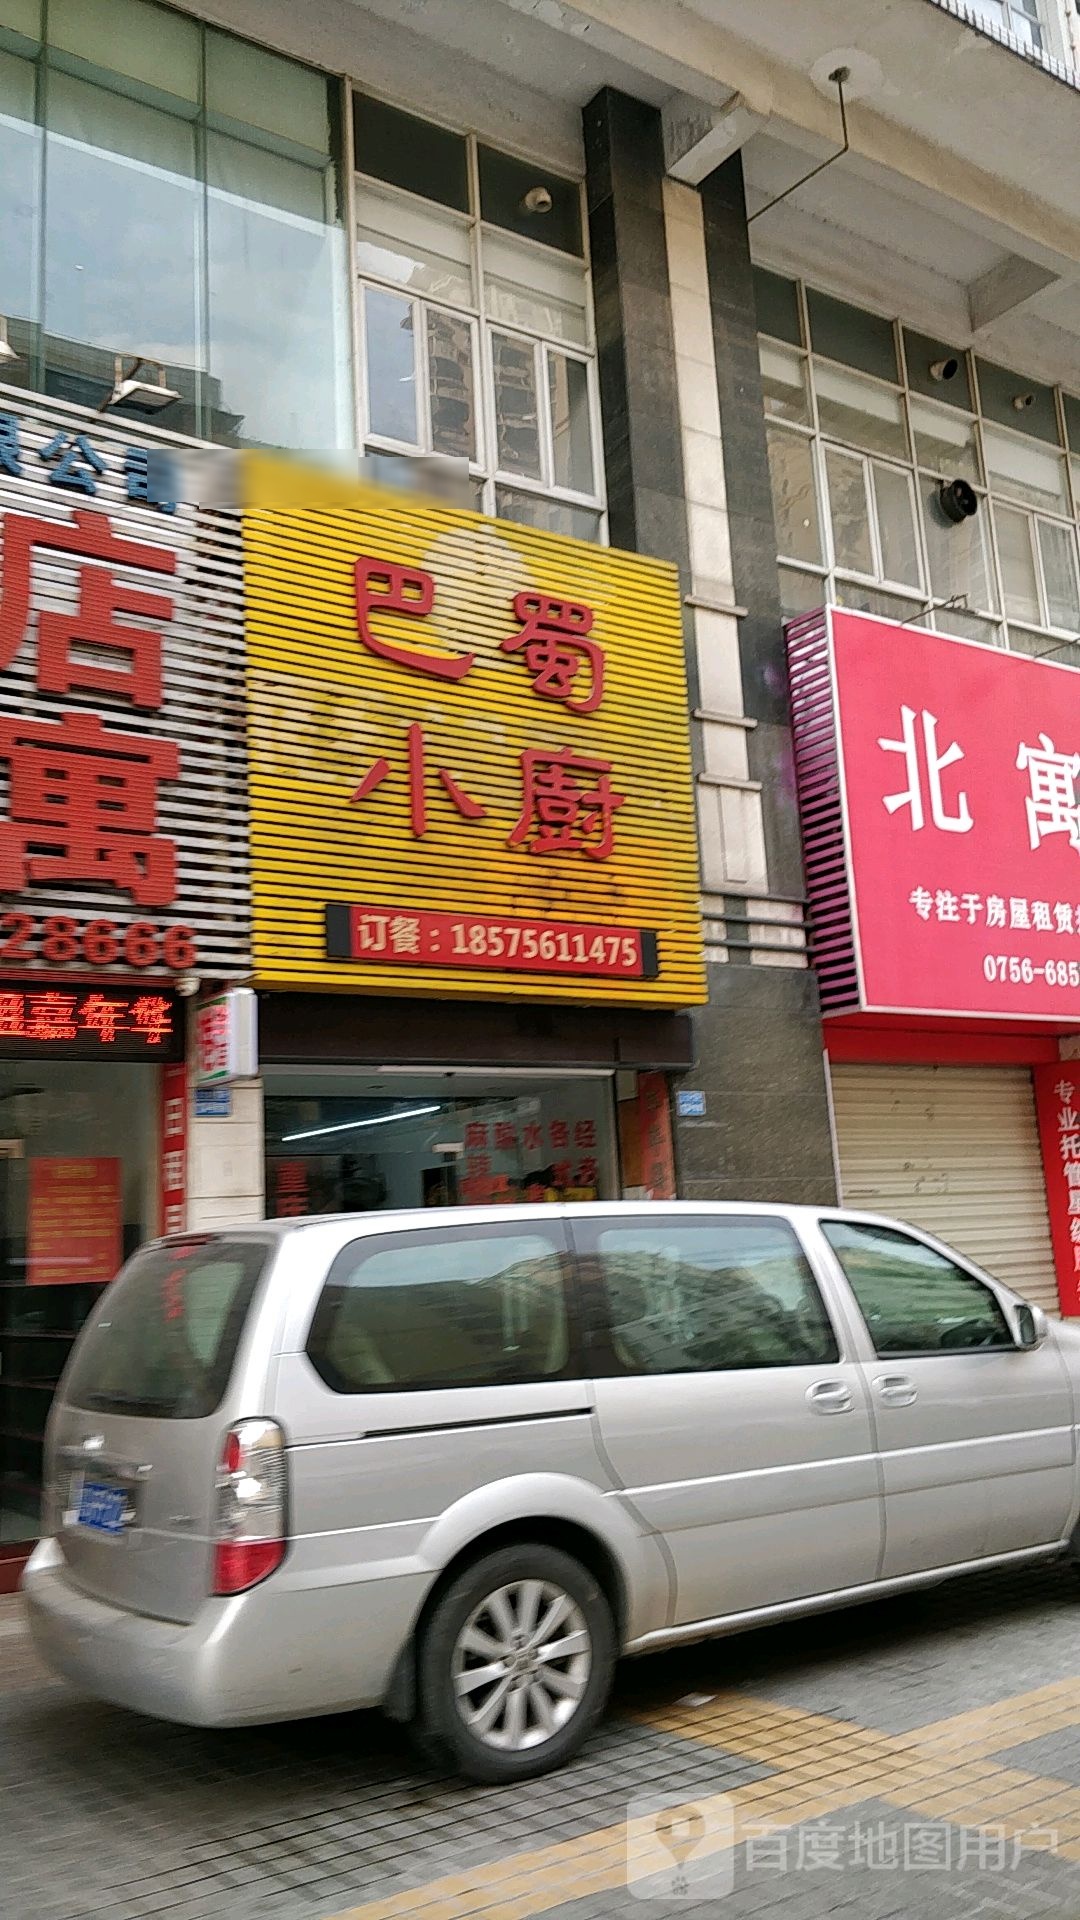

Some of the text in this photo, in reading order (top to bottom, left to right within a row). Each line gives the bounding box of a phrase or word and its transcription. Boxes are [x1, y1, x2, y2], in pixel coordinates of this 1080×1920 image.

[0, 510, 177, 709] 店
[354, 556, 605, 713] 巴蜀
[909, 885, 1080, 936] 专注于房屋租赁
